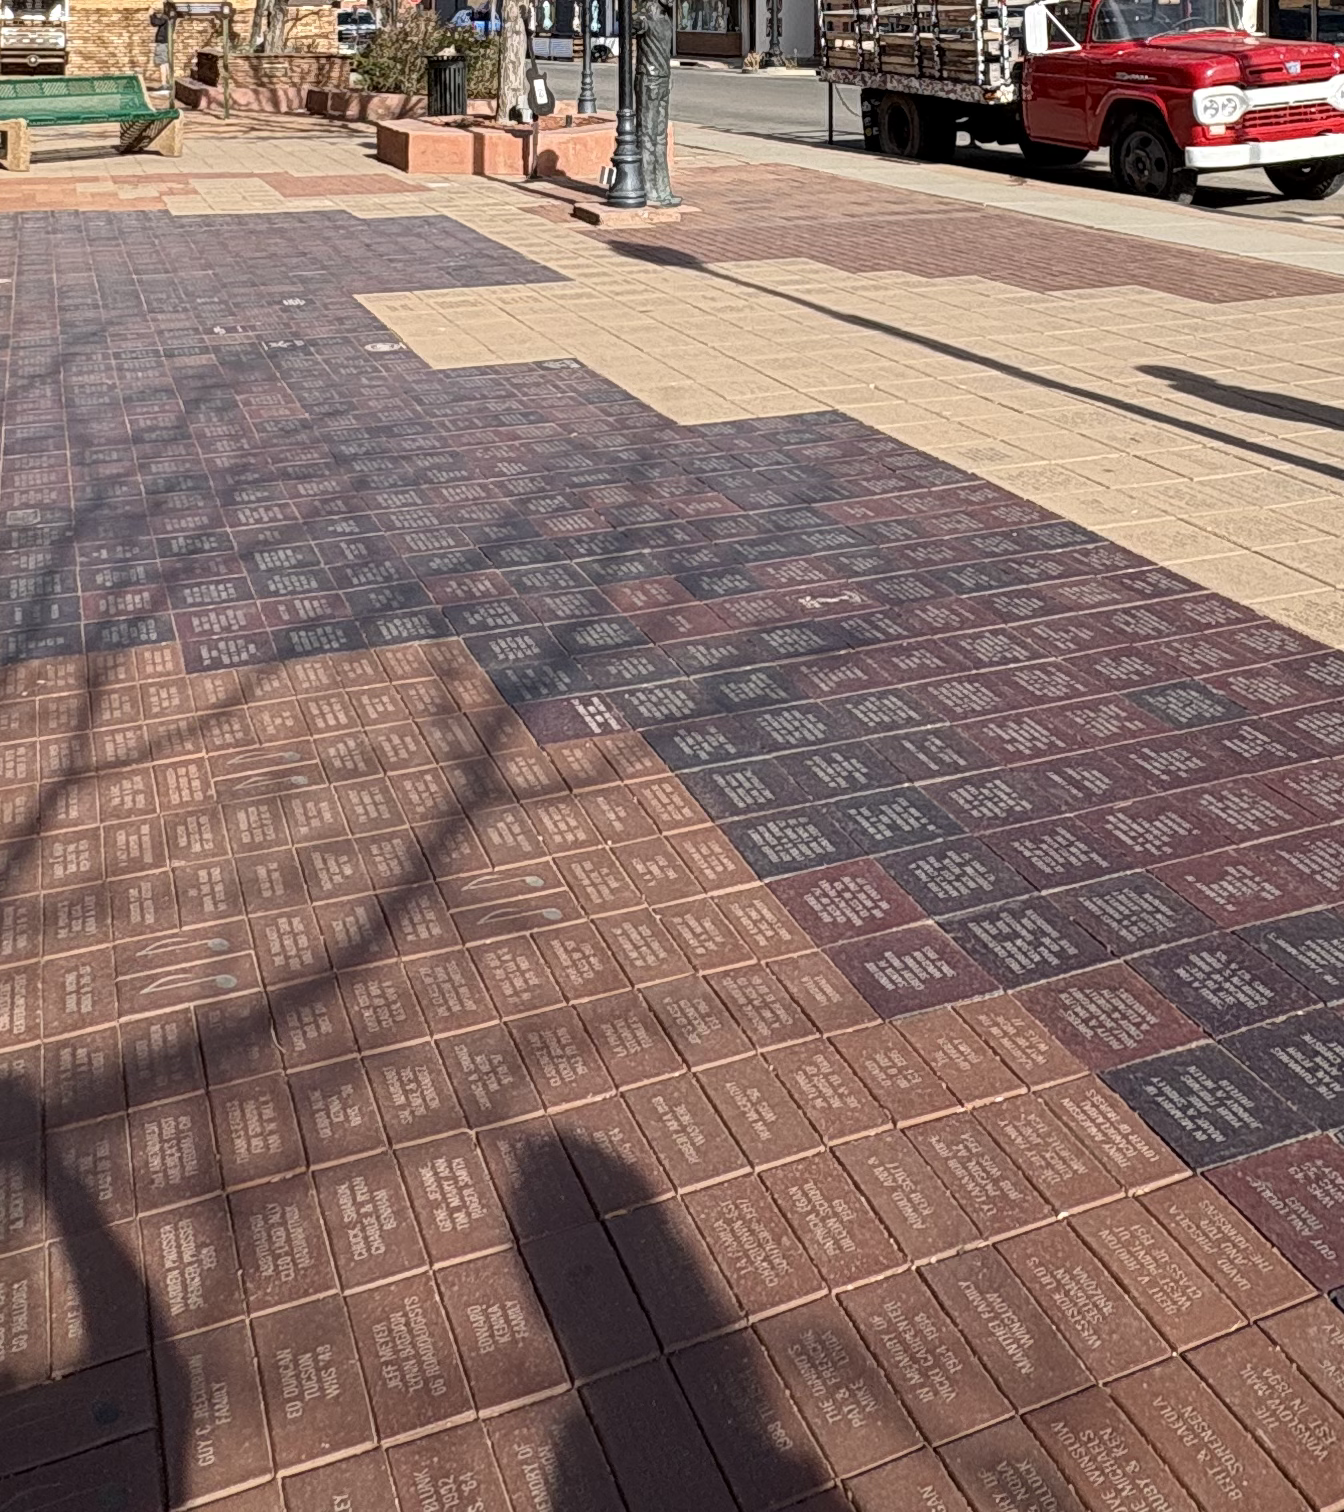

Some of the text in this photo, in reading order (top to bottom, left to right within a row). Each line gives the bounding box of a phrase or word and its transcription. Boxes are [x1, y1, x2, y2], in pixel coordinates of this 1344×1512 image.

[1056, 1096, 1109, 1141] ANDERSON
[1082, 1088, 1163, 1162] LOVER OF HORSES
[870, 1164, 898, 1188] ANN
[883, 1160, 919, 1192] SCOTT
[784, 1185, 814, 1212] EGAN
[797, 1178, 836, 1217] SCHOOL
[1111, 1224, 1135, 1241] UT
[1162, 1203, 1222, 1255] PRISCILLA
[1127, 1223, 1206, 1300] CLASS OF 1951
[1218, 1241, 1251, 1267] AND
[1247, 1251, 1277, 1273] THE
[955, 1277, 998, 1318] FAMILY
[1049, 1266, 1109, 1324] SELIGMAN
[1067, 1264, 1120, 1315] ARIZONA
[1145, 1284, 1182, 1315] BERT
[1156, 1275, 1197, 1310] WEST
[464, 1302, 499, 1354] EDWARD
[483, 1302, 515, 1344] KENNA
[500, 1297, 533, 1339] FAMILY
[982, 1289, 1039, 1348] WINSLOW
[1049, 1290, 1108, 1348] WESTSIDE
[10, 1332, 30, 1353] GO
[369, 1320, 407, 1392] JEFF MEYER
[273, 1346, 307, 1419] ED DUNCAN
[294, 1351, 324, 1400] TUCSON
[319, 1365, 344, 1399] WHS
[400, 1356, 427, 1392] LYNN
[1259, 1365, 1295, 1396] 1894
[1250, 1404, 1282, 1430] THE
[1286, 1395, 1313, 1415] IN
[1176, 1403, 1248, 1475] SORENSEN
[1264, 1395, 1334, 1461] WINSLOW
[1192, 1446, 1215, 1463] &
[1205, 1462, 1247, 1501] BERT
